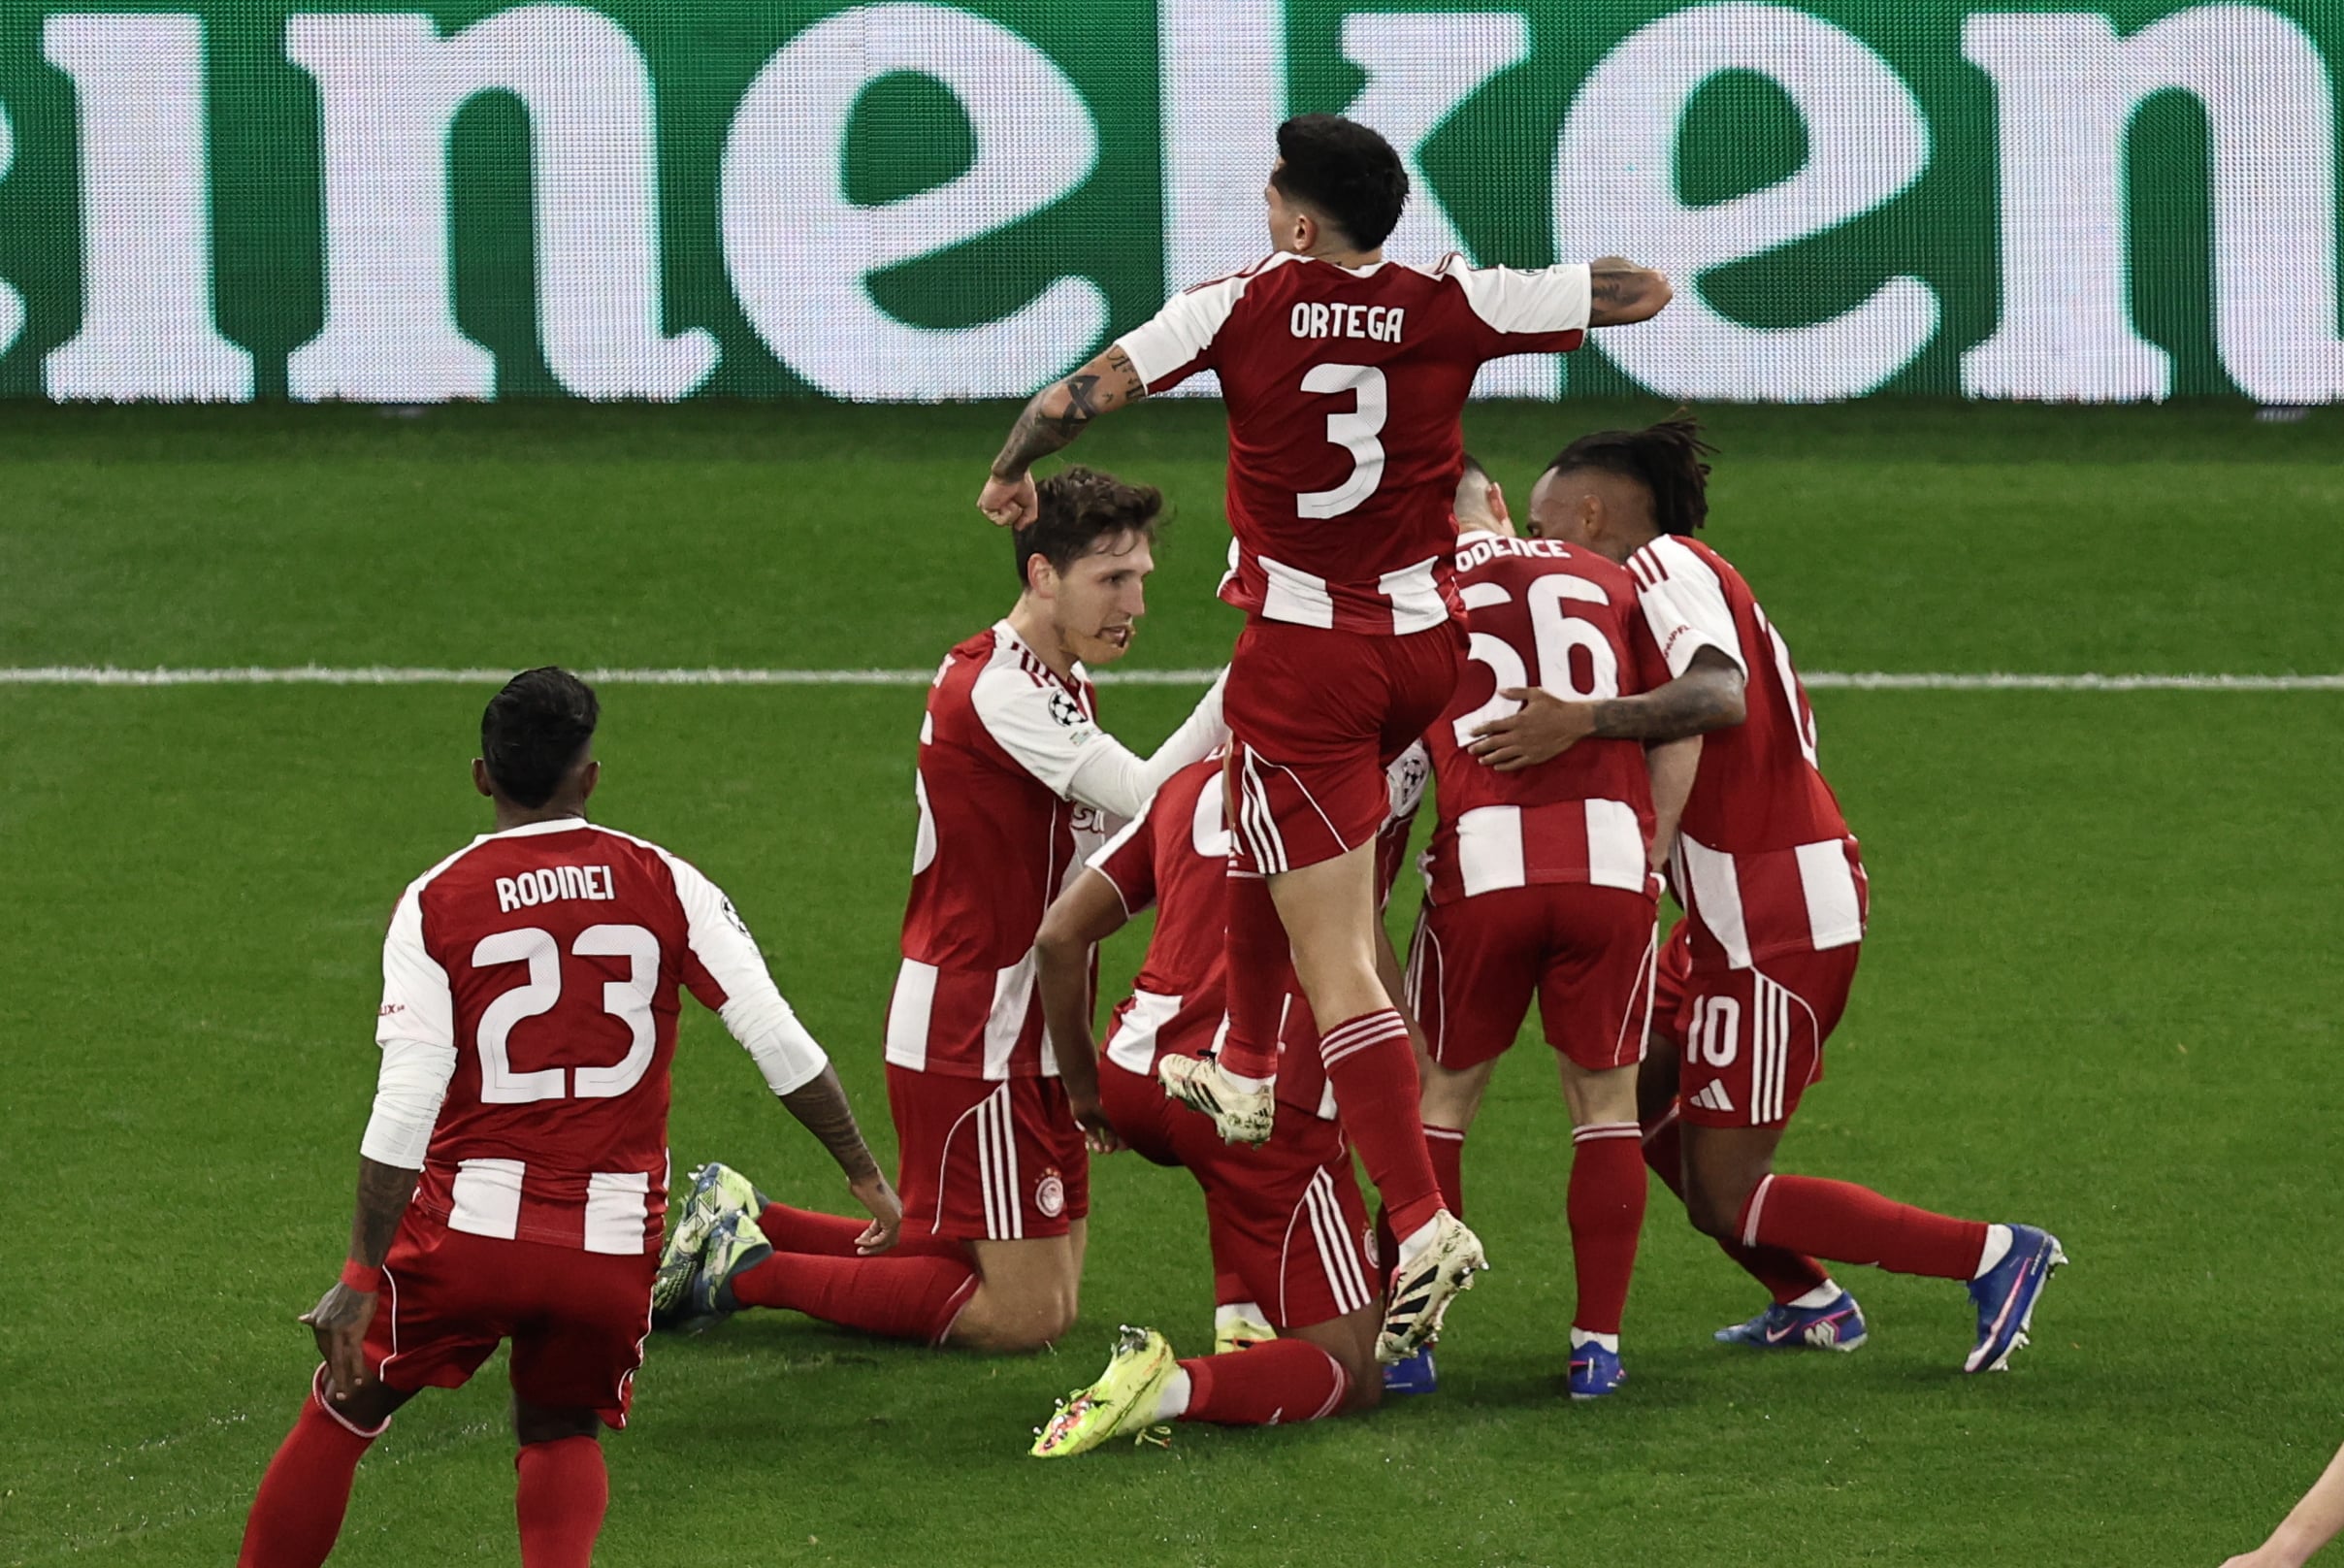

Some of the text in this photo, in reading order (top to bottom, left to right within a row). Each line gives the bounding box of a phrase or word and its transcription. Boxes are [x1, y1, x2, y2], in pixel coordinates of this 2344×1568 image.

[0, 0, 2344, 403] ineken
[1290, 302, 1405, 343] ORTEGA
[1296, 363, 1387, 520] 3
[1455, 537, 1573, 572] ODENCE
[495, 866, 616, 913] RODINEI
[472, 924, 661, 1104] 23
[1686, 994, 1741, 1067] 10
